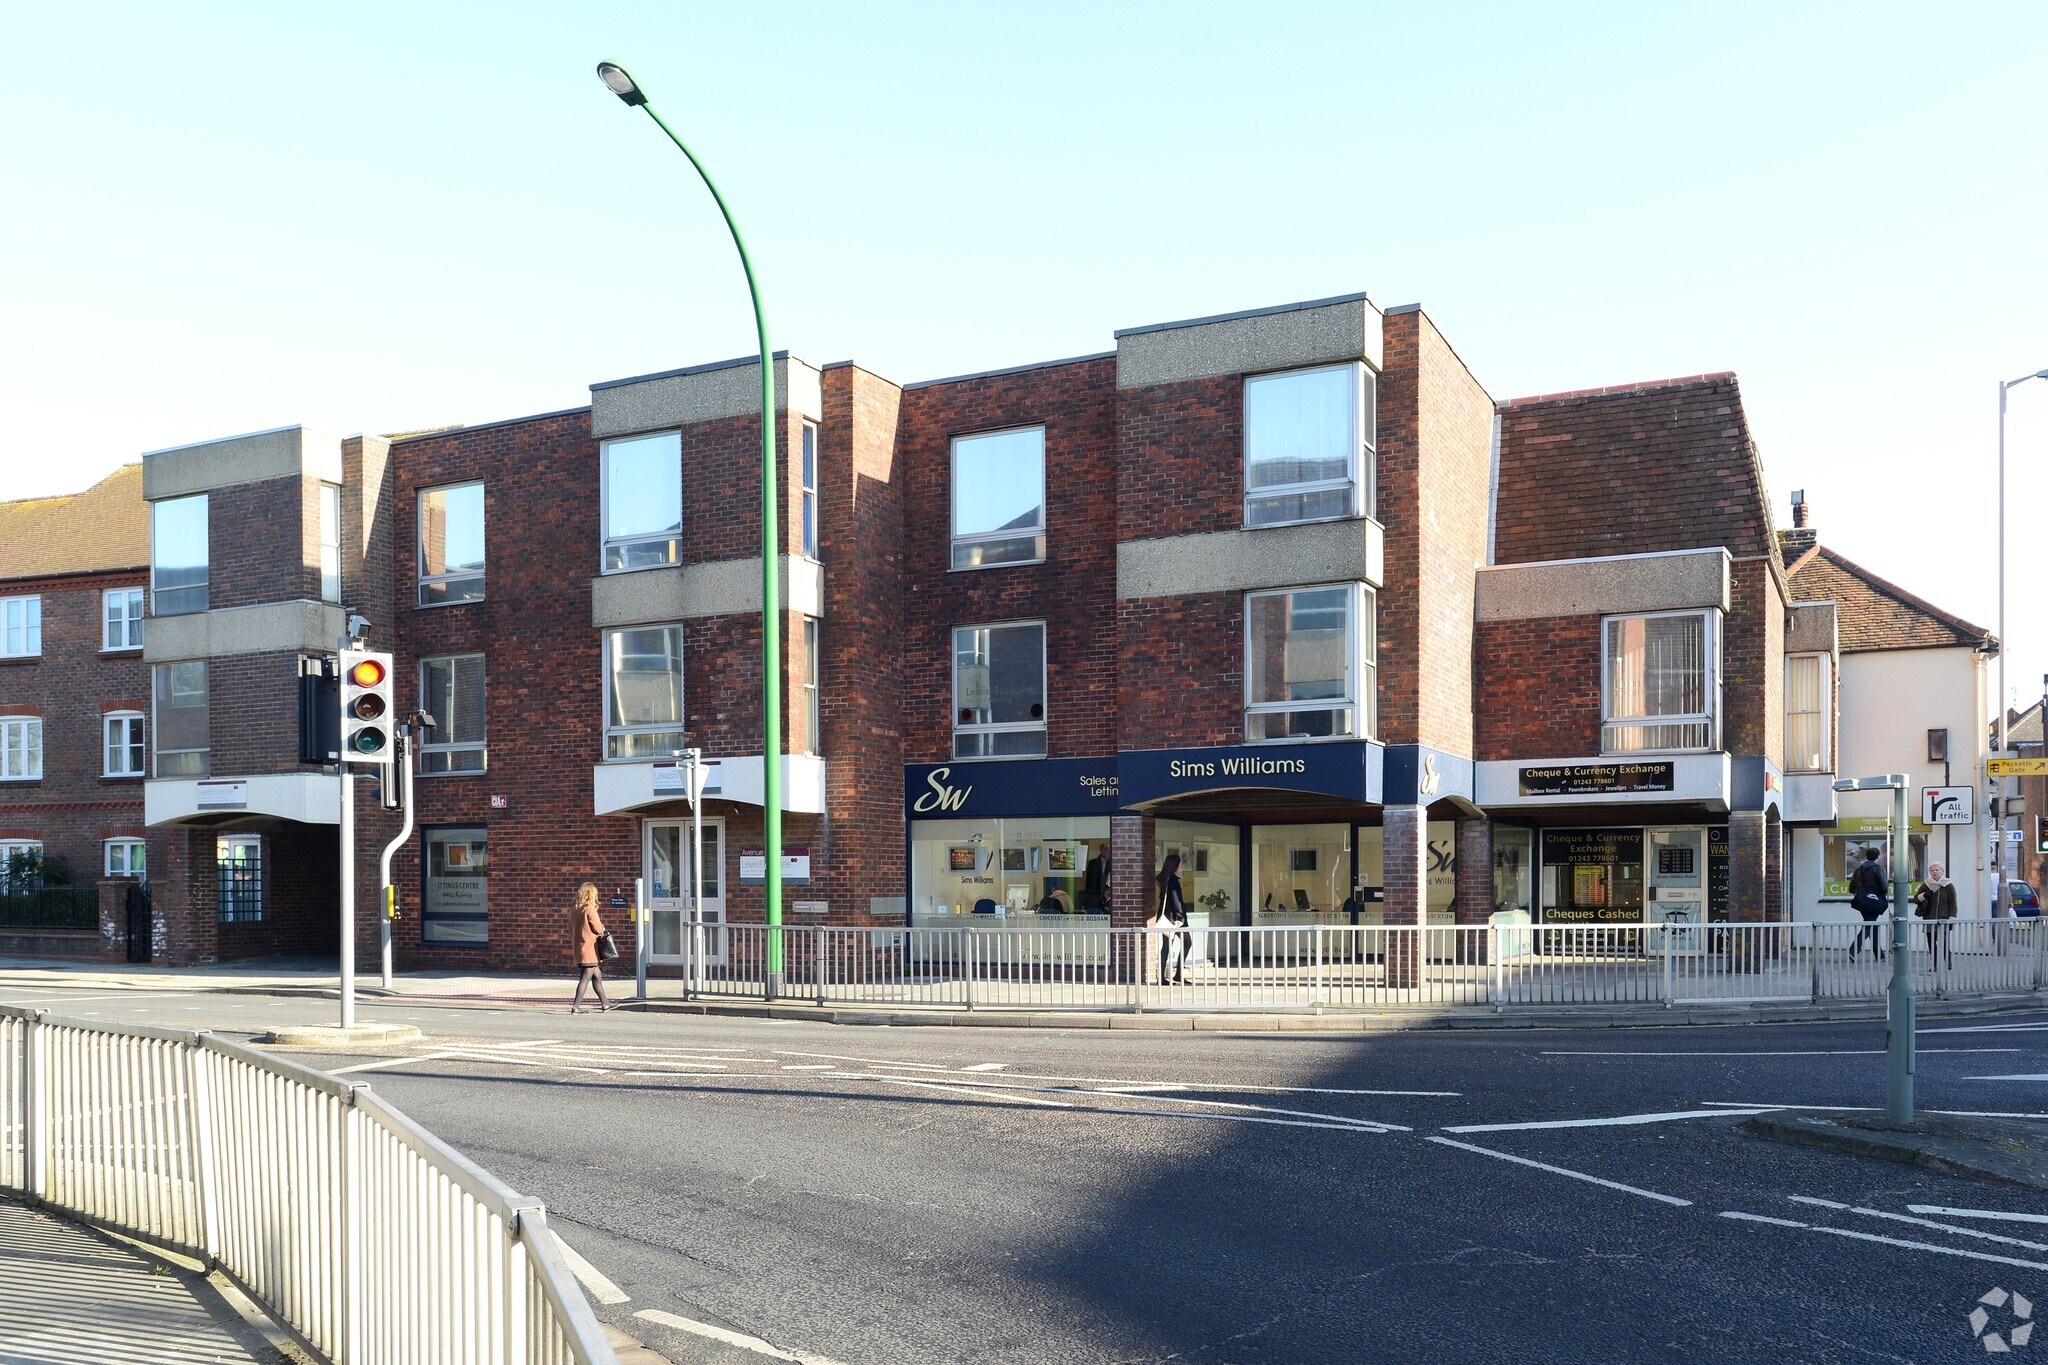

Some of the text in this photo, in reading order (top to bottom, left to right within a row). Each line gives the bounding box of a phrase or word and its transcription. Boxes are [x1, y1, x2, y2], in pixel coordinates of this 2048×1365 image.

[1170, 756, 1305, 777] Sims Williams
[1526, 764, 1666, 779] Cheque & Currency Exchange
[1080, 776, 1107, 786] Sales
[1091, 786, 1119, 796] Lettin
[1546, 834, 1583, 844] Cheque
[1596, 833, 1641, 843] Currency
[1570, 844, 1617, 853] Exchange
[961, 876, 973, 884] Sims
[1546, 908, 1640, 920] Cheques Cashed
